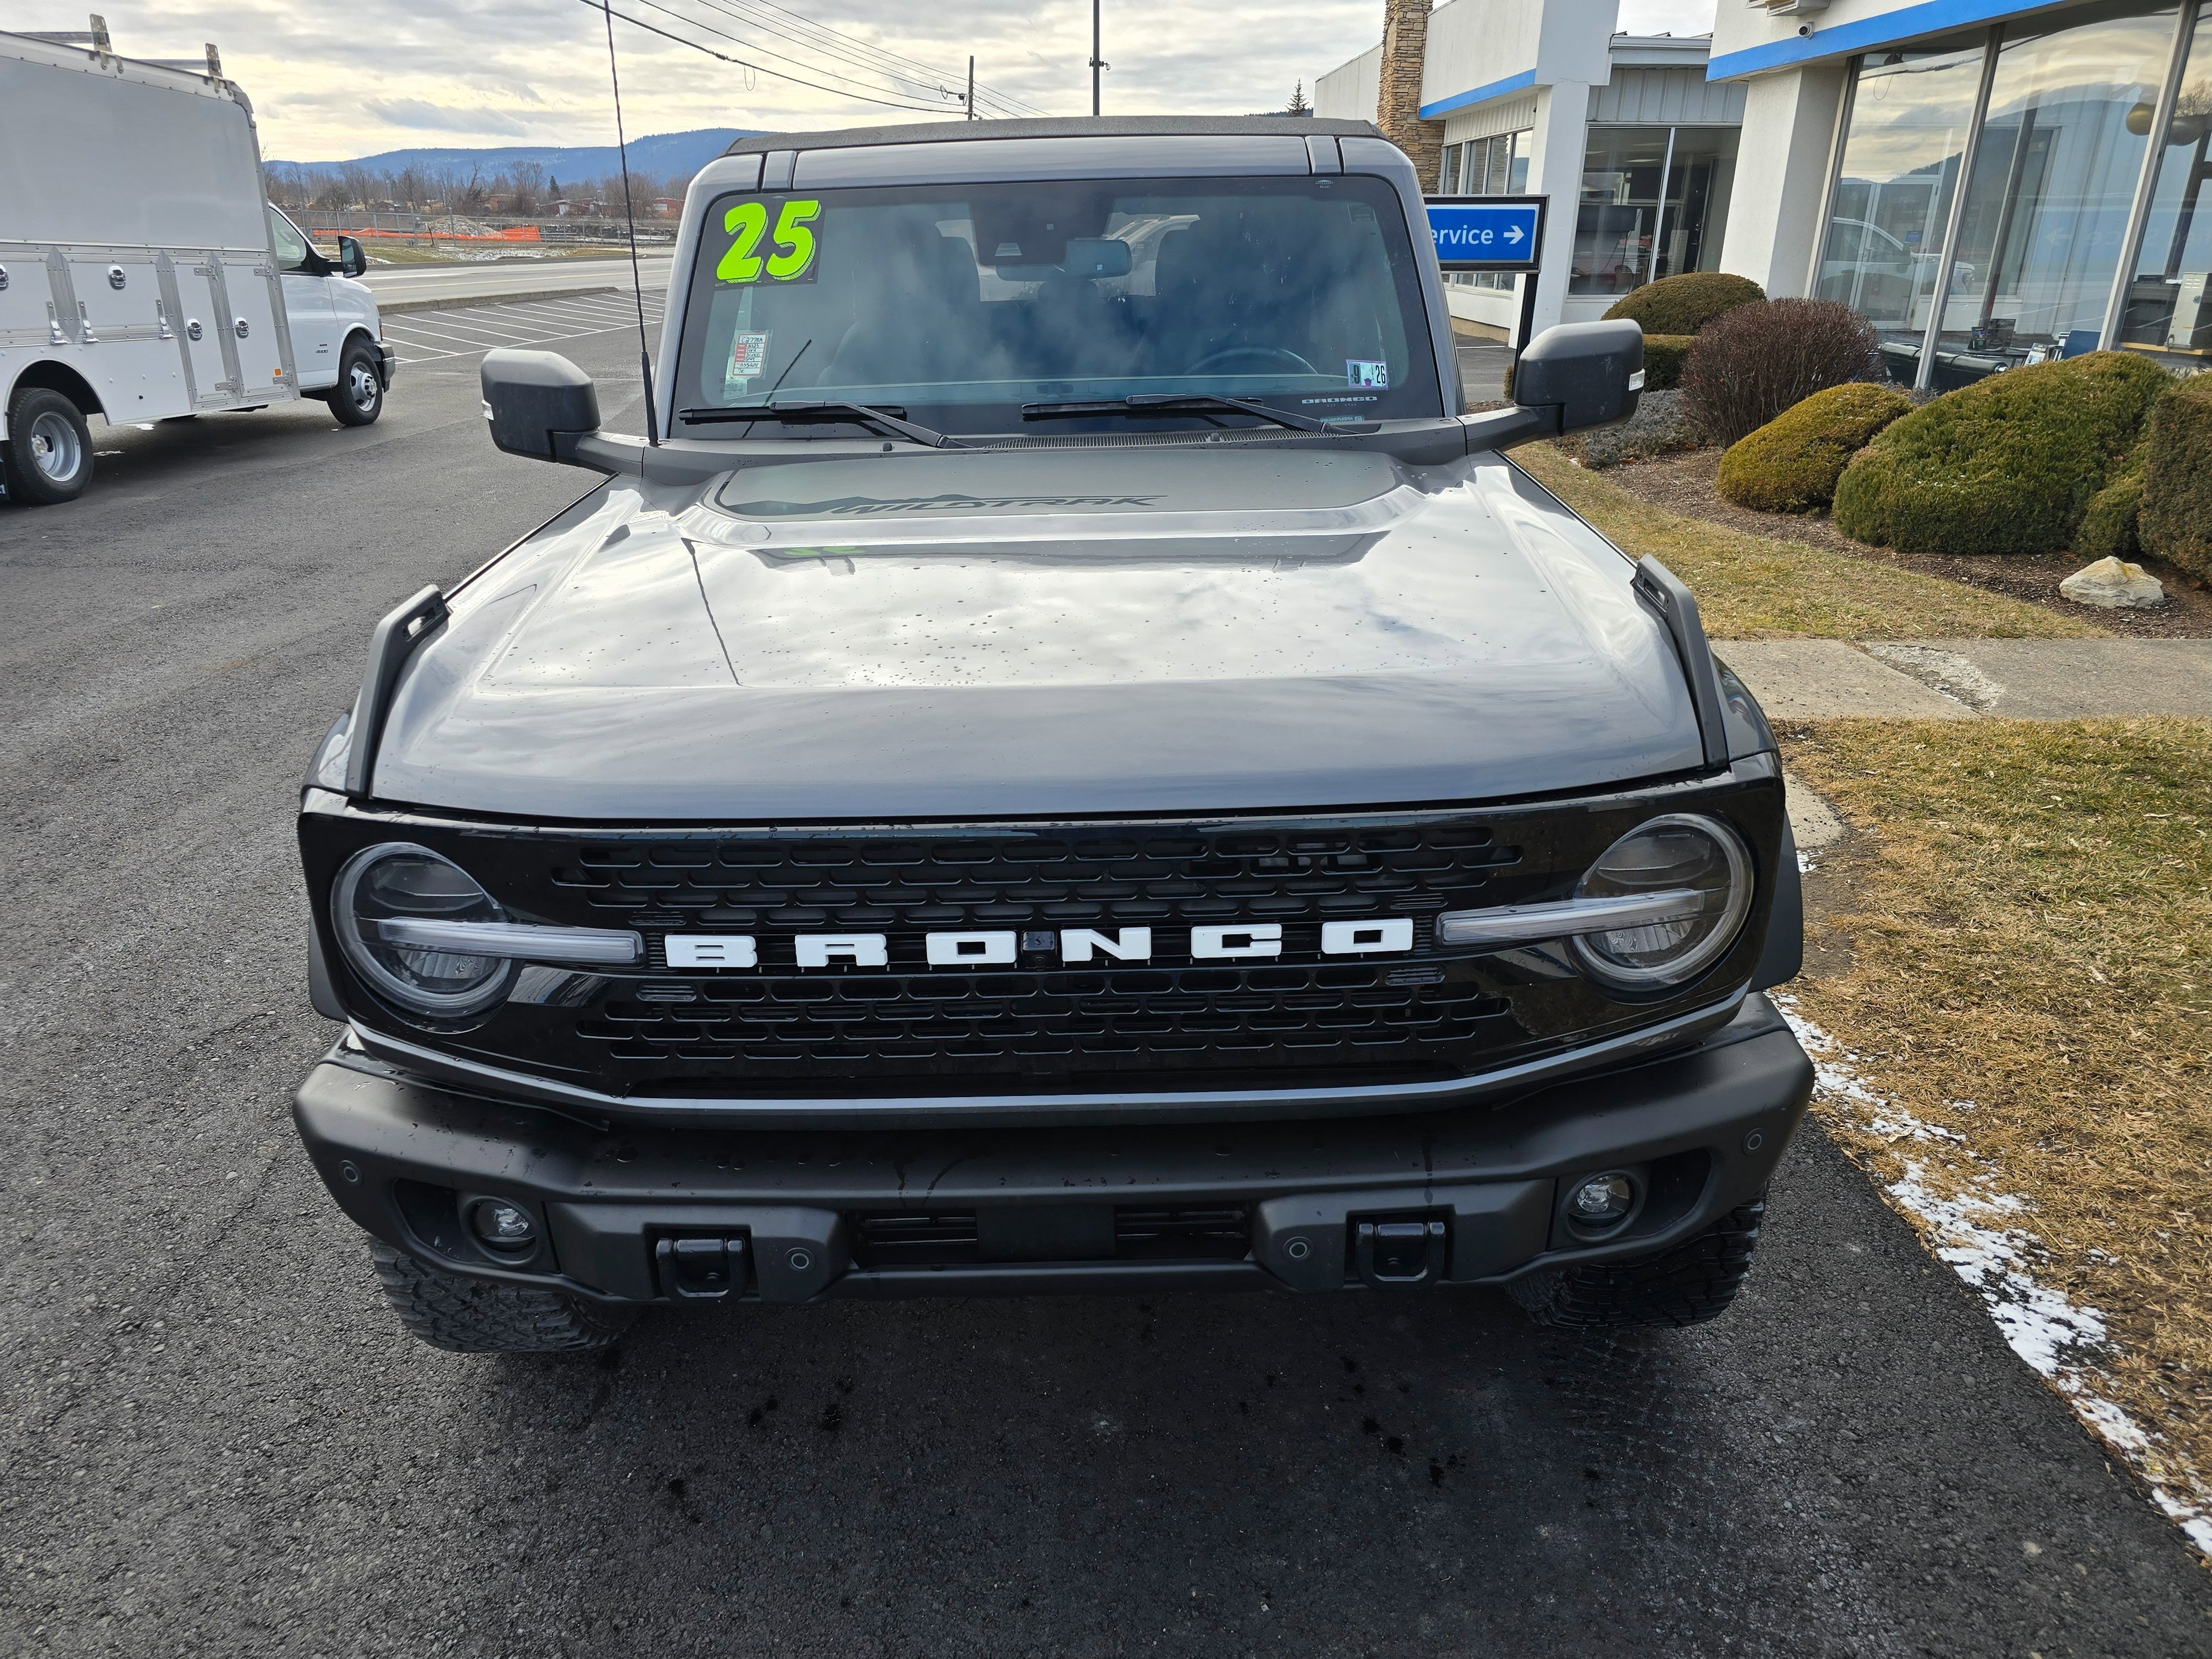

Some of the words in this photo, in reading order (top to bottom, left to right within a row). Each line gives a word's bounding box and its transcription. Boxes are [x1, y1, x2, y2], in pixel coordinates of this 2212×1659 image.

[716, 200, 823, 284] 25
[1430, 225, 1493, 244] ervice
[1353, 364, 1360, 384] 9
[1375, 365, 1386, 384] 26
[1301, 396, 1378, 404] BRONCO
[830, 497, 1160, 515] WILDTRAK
[664, 918, 1413, 968] BRONCO
